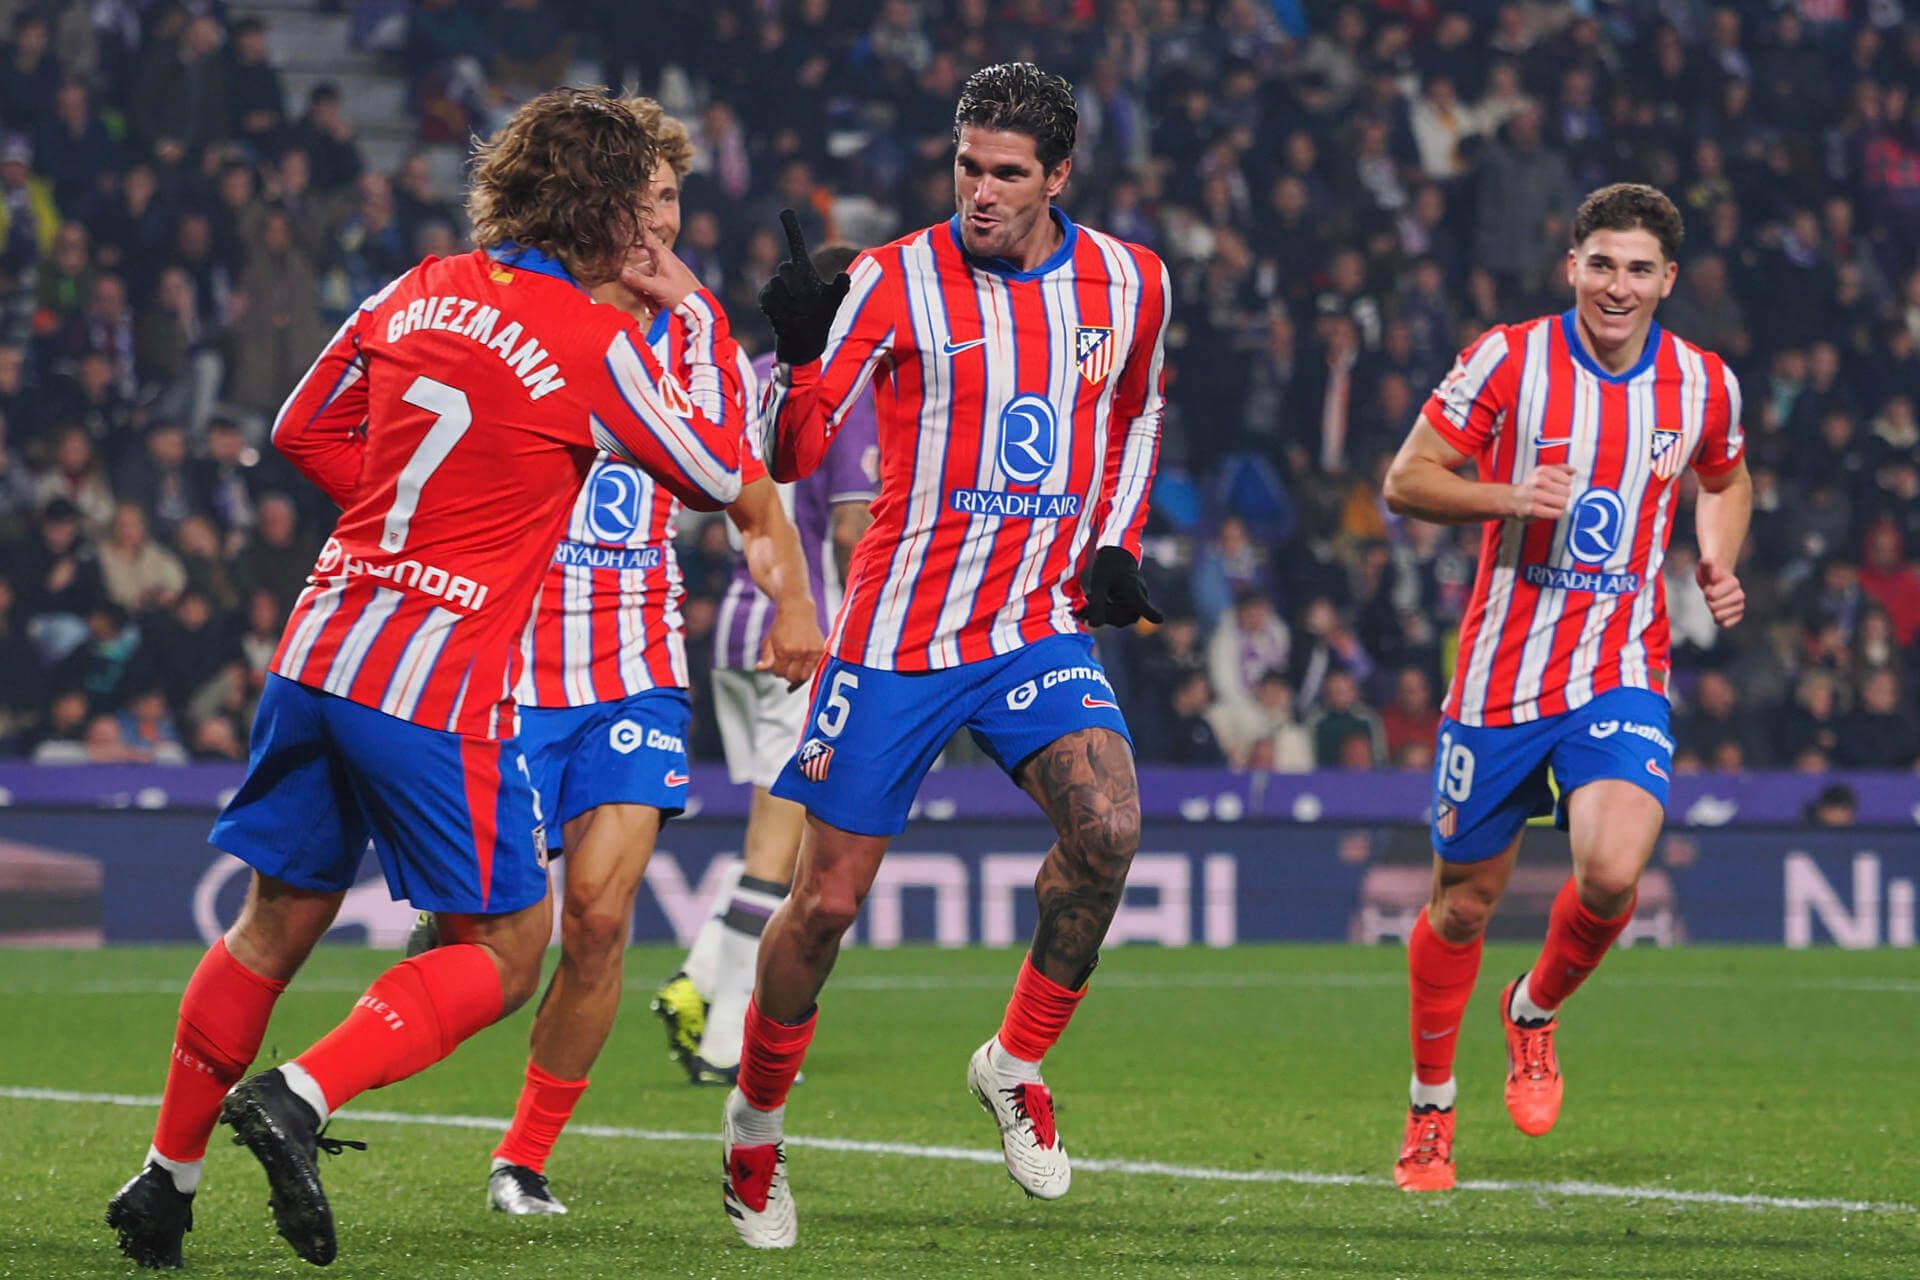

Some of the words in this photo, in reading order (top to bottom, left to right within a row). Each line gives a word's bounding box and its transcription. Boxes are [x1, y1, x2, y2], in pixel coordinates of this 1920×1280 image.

[387, 296, 566, 401] GRIEZMANN
[379, 375, 473, 554] 7
[955, 491, 1041, 516] RIYADH
[1045, 496, 1077, 515] AIR
[628, 549, 659, 566] AIR
[1527, 565, 1601, 591] RIYADH
[1604, 575, 1636, 592] AIR
[817, 669, 859, 738] 5
[1438, 732, 1475, 802] 19
